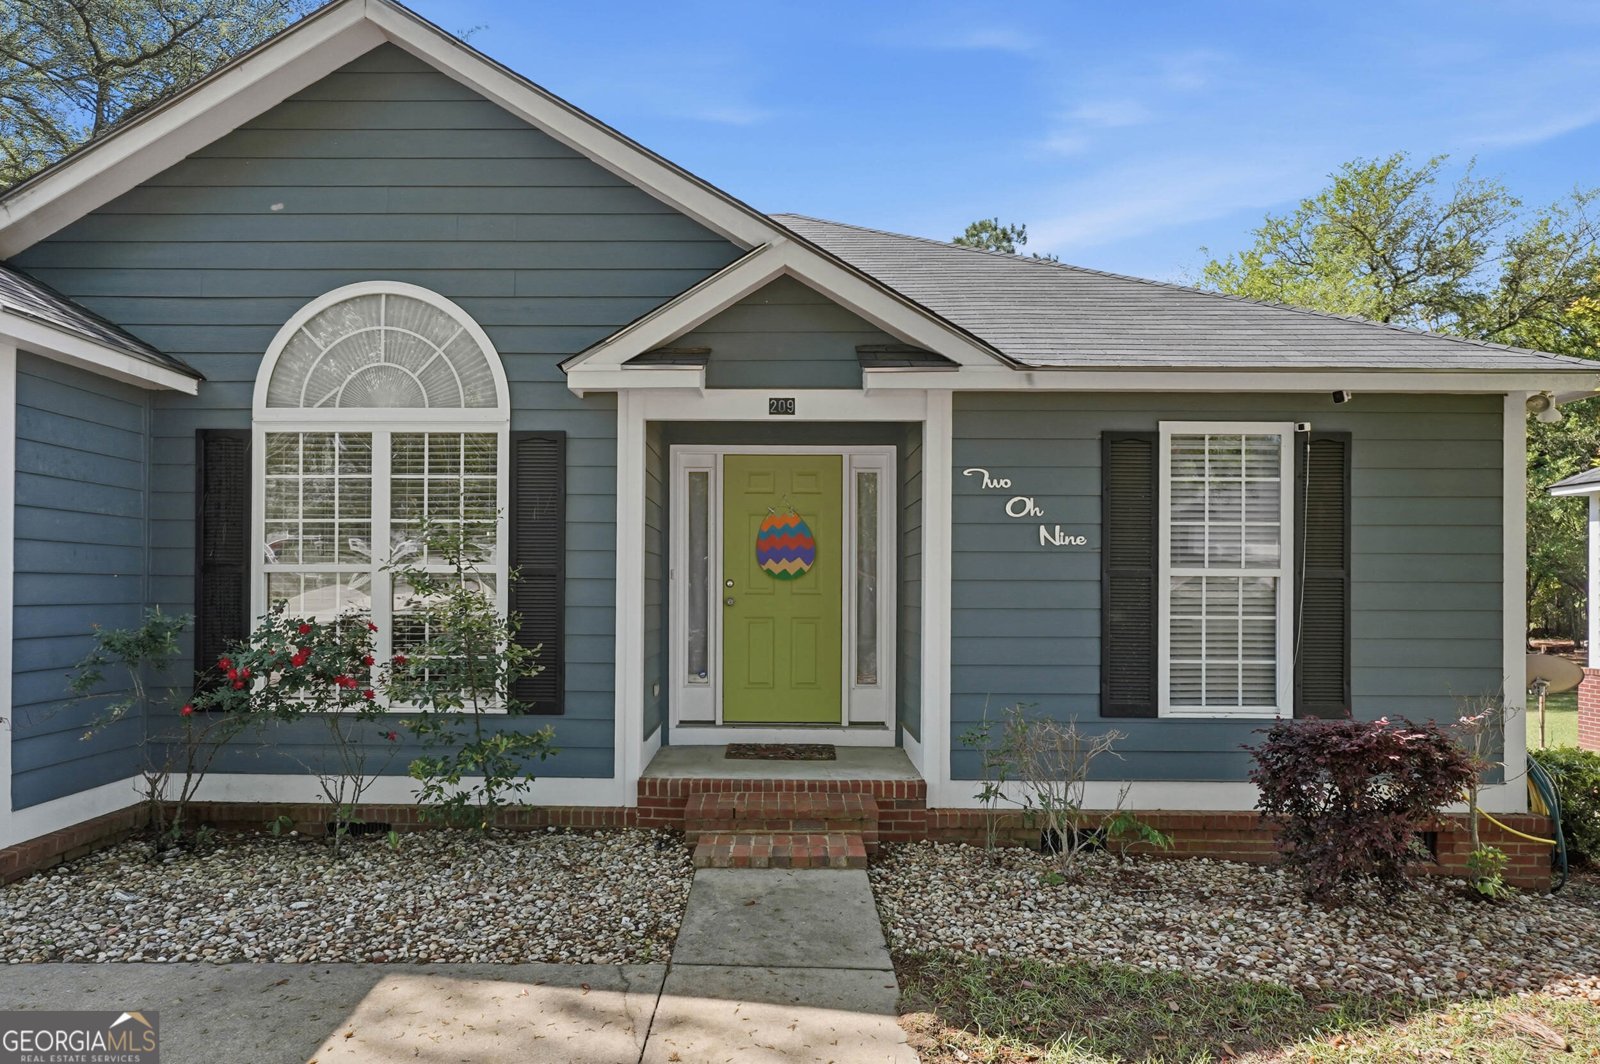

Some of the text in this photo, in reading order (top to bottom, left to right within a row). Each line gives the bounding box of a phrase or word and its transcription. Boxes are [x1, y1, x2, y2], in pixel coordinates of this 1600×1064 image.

[770, 399, 794, 413] 209
[963, 468, 1012, 489] Two
[1005, 496, 1044, 518] Oh
[1039, 525, 1087, 546] Nine
